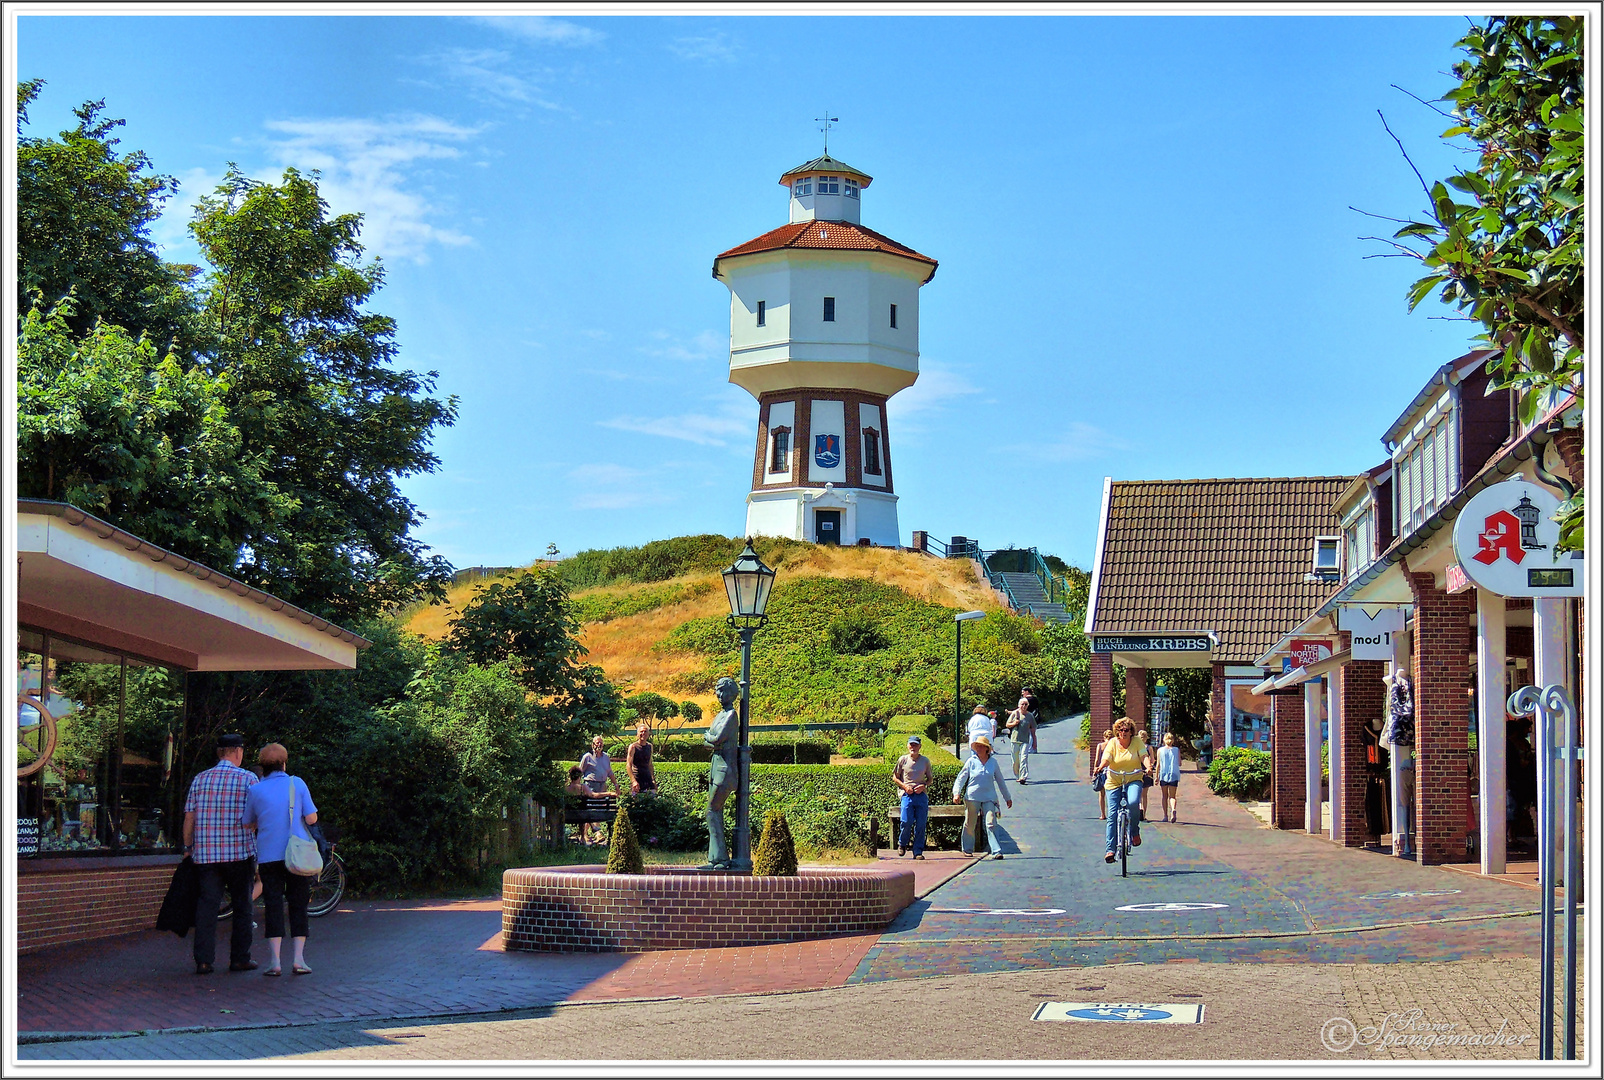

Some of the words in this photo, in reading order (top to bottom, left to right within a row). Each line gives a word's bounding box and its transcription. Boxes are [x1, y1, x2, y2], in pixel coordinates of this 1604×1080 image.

[1148, 639, 1207, 650] KREBS
[1354, 635, 1381, 645] mod
[1384, 632, 1390, 645] 1
